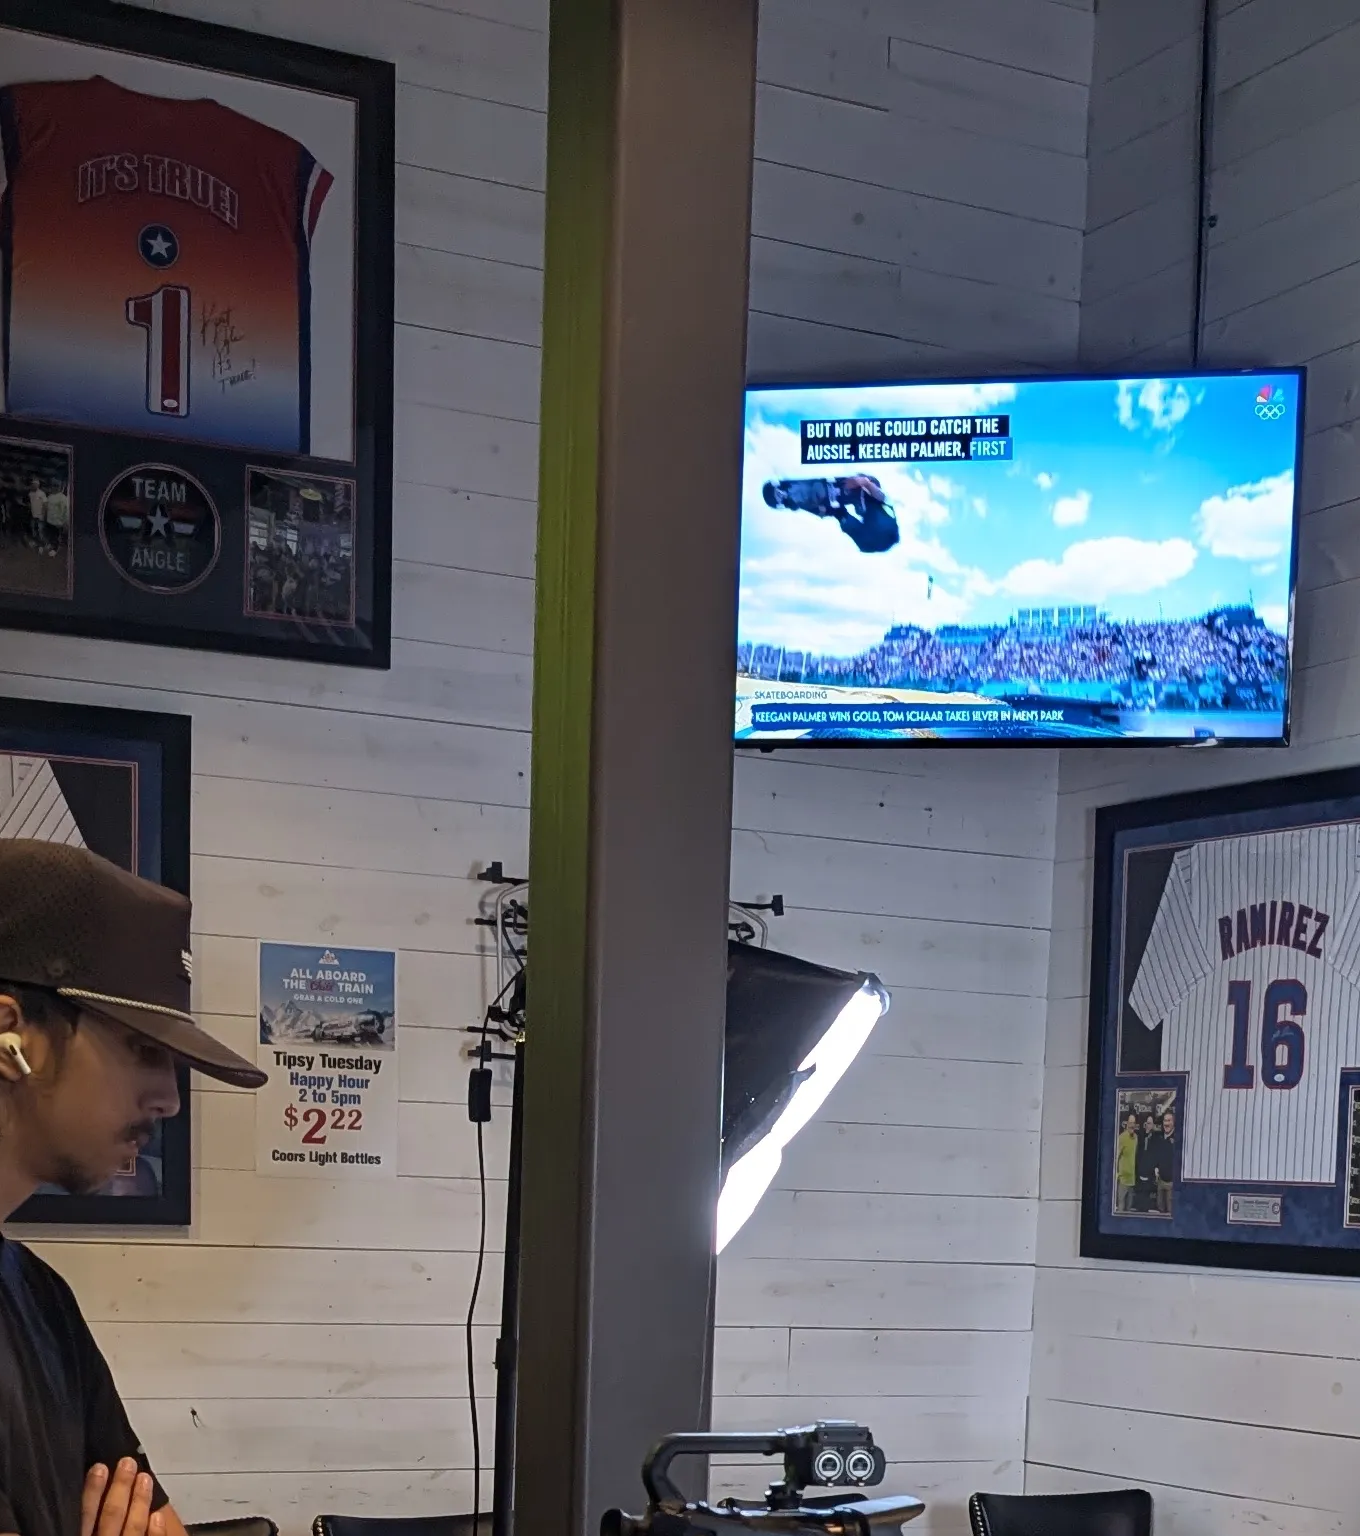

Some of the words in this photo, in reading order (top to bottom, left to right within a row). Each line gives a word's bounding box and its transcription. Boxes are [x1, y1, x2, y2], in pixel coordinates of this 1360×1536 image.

[78, 153, 139, 203] IT'S
[143, 153, 239, 230] TRUE!
[126, 285, 191, 418] 1
[806, 422, 831, 438] BUT
[835, 422, 852, 438] NO
[856, 421, 881, 437] ONE
[884, 420, 927, 436] COULD
[930, 419, 971, 435] CATCH
[974, 418, 999, 434] THE
[807, 444, 855, 461] AUSSIE,
[858, 443, 907, 459] KEEGAN
[910, 441, 966, 458] PALMER,
[969, 440, 1007, 456] FIRST
[132, 478, 187, 502] TEAM
[132, 547, 185, 572] ANGLE
[754, 690, 828, 700] SKATEBOARDING
[755, 711, 791, 723] KEEGAN
[792, 711, 827, 722] PALMER
[829, 711, 851, 722] WINS
[852, 711, 881, 723] GOLD,
[883, 711, 904, 722] TOM
[906, 711, 943, 722] SCHAAR
[944, 711, 971, 722] TAKES
[973, 711, 999, 722] SILVER
[1001, 711, 1011, 721] IN
[1013, 711, 1039, 722] MEN'S
[1040, 711, 1064, 722] PARK
[1218, 900, 1330, 961] RAMIREZ
[291, 968, 312, 979] ALL
[316, 970, 366, 982] ABOARD
[283, 979, 306, 990] THE
[337, 982, 373, 994] TRAIN
[293, 993, 315, 1002] GRAB
[1223, 978, 1308, 1090] 16
[273, 1051, 315, 1068] Tipsy
[321, 1053, 382, 1075] Tuesday
[290, 1072, 333, 1090] Happy
[339, 1074, 370, 1089] Hour
[299, 1089, 308, 1103] 2
[312, 1090, 327, 1104] to
[331, 1091, 361, 1107] 5pm
[272, 1150, 306, 1163] Coors
[309, 1151, 338, 1166] Light
[340, 1153, 381, 1165] Bottles
